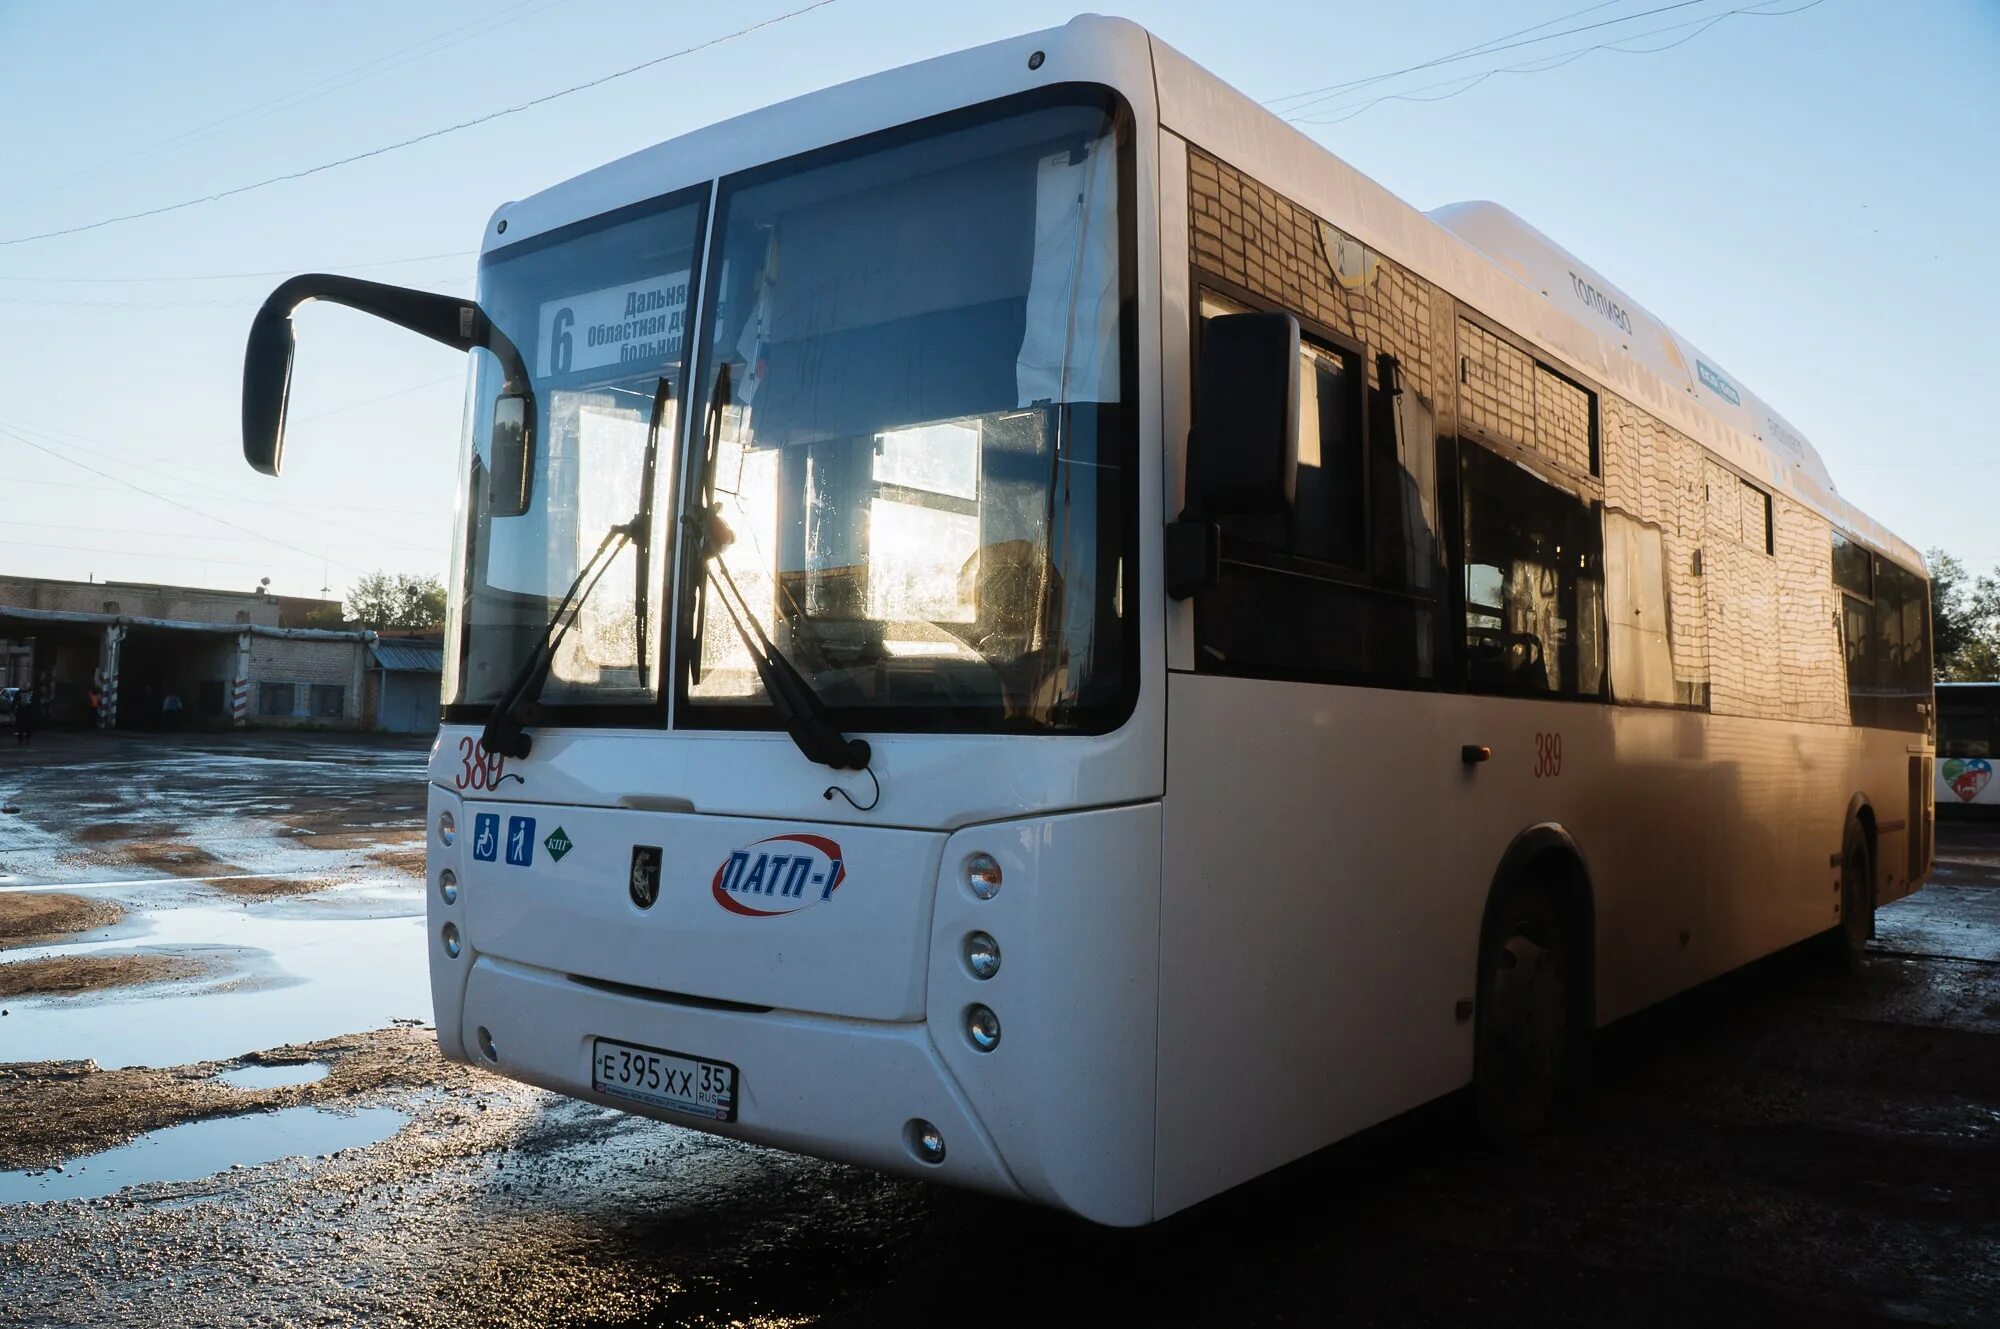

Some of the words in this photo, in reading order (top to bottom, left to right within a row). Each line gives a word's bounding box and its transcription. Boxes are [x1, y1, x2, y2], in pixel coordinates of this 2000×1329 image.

[624, 283, 689, 319] Дальня
[1569, 271, 1632, 335] ТОПЛИВО
[551, 307, 574, 376] 6
[587, 313, 665, 347] Областная
[456, 736, 504, 792] 389
[1534, 733, 1562, 777] 389
[548, 838, 570, 850] КПГ
[720, 850, 842, 901] ПАТП-1
[604, 1052, 693, 1098] Е395ХХ
[701, 1066, 724, 1093] 35
[699, 1091, 717, 1103] RUS
